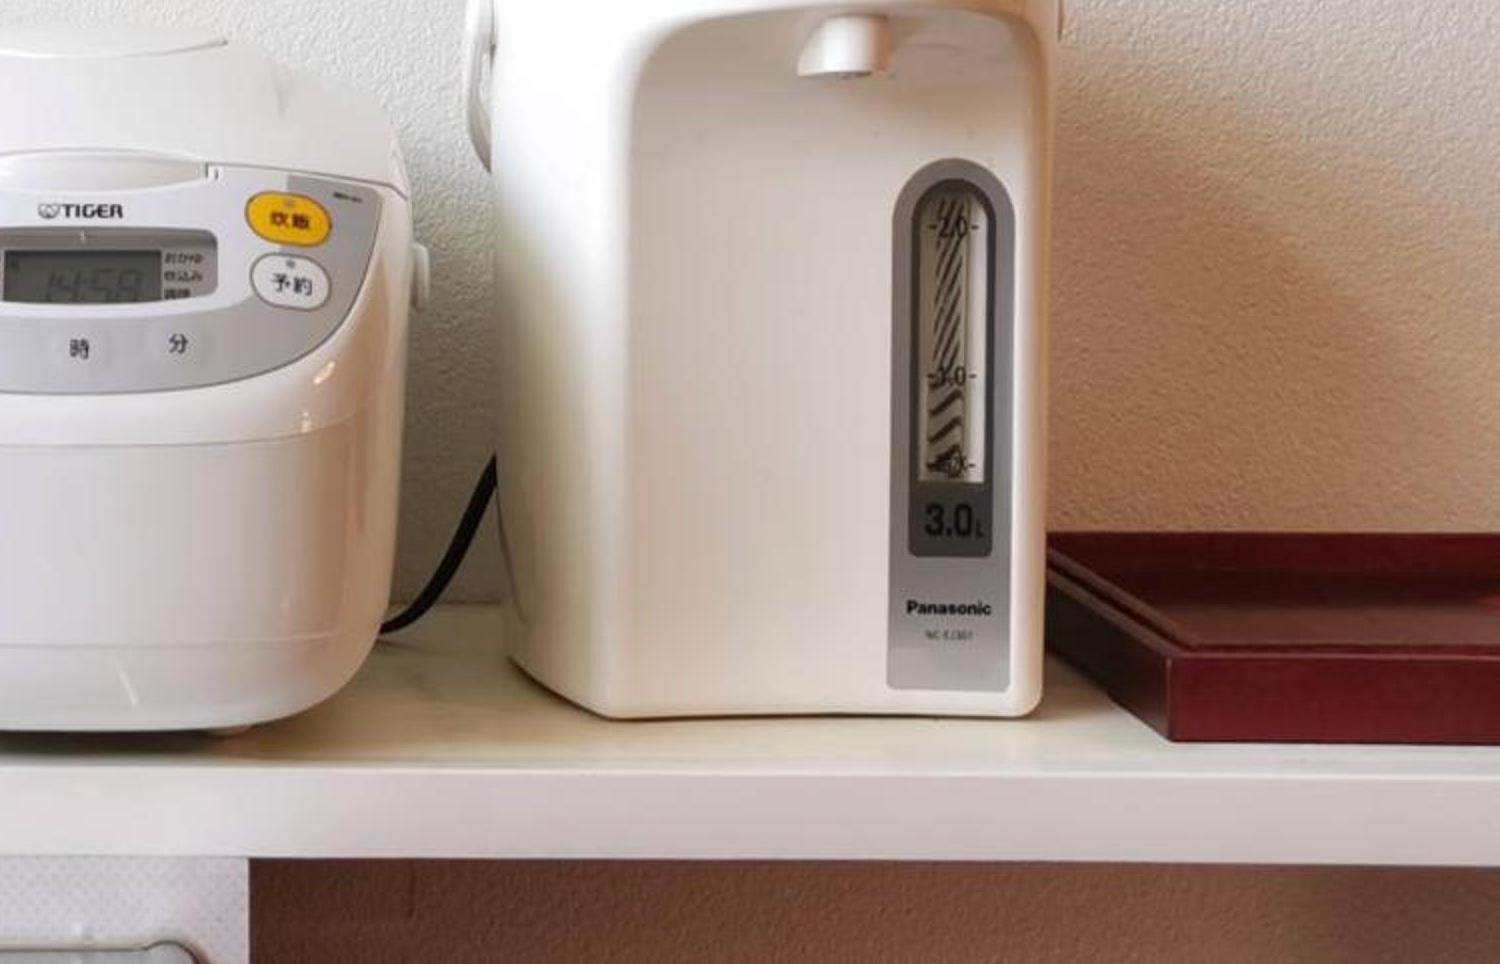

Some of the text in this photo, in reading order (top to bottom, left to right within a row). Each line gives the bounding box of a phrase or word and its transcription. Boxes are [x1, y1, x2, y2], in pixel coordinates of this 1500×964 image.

[62, 203, 123, 218] TIGER
[270, 212, 311, 231] 炊飯
[272, 273, 312, 296] 予約
[69, 338, 90, 360] 時
[169, 333, 189, 354] 分
[906, 599, 992, 616] Panasonic
